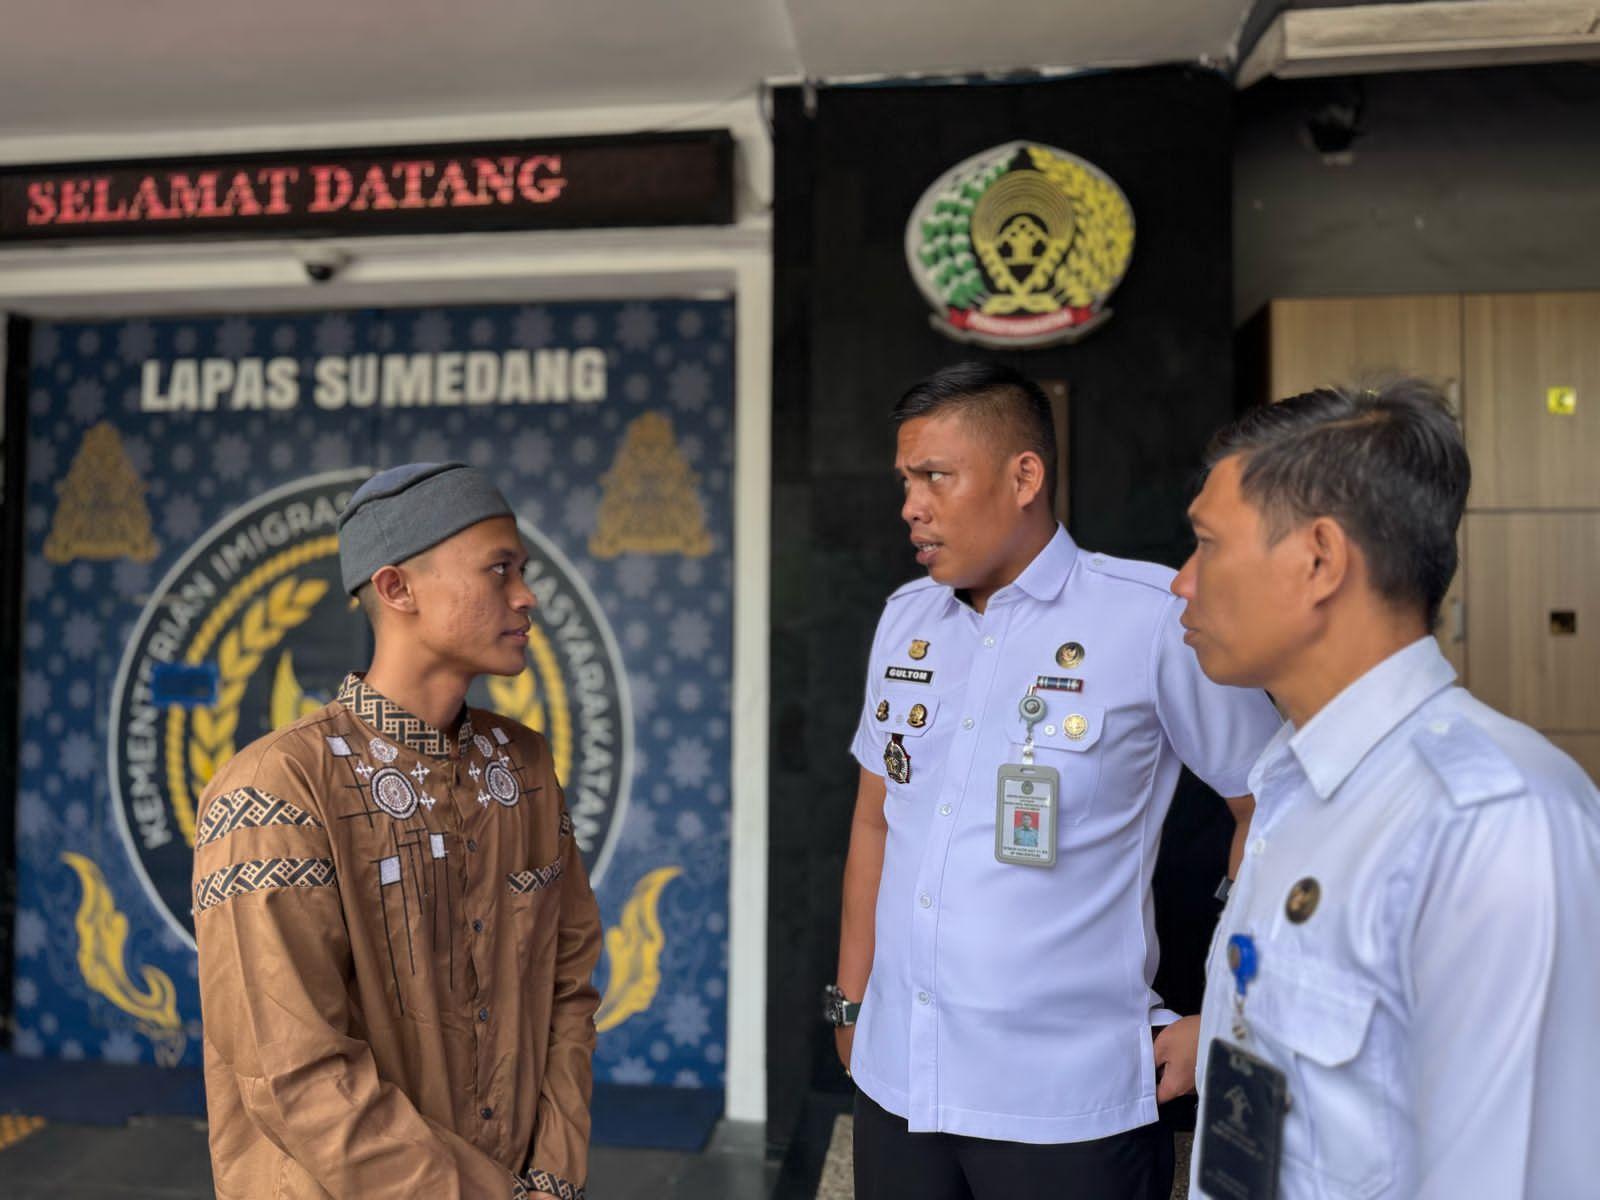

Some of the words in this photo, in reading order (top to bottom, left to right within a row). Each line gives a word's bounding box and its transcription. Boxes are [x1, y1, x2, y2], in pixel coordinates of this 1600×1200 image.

[27, 165, 299, 226] SELAMAT
[307, 155, 567, 213] DATANG
[140, 356, 299, 413] LAPAS
[313, 347, 608, 410] SUMEDANG
[888, 668, 928, 681] GULTOM
